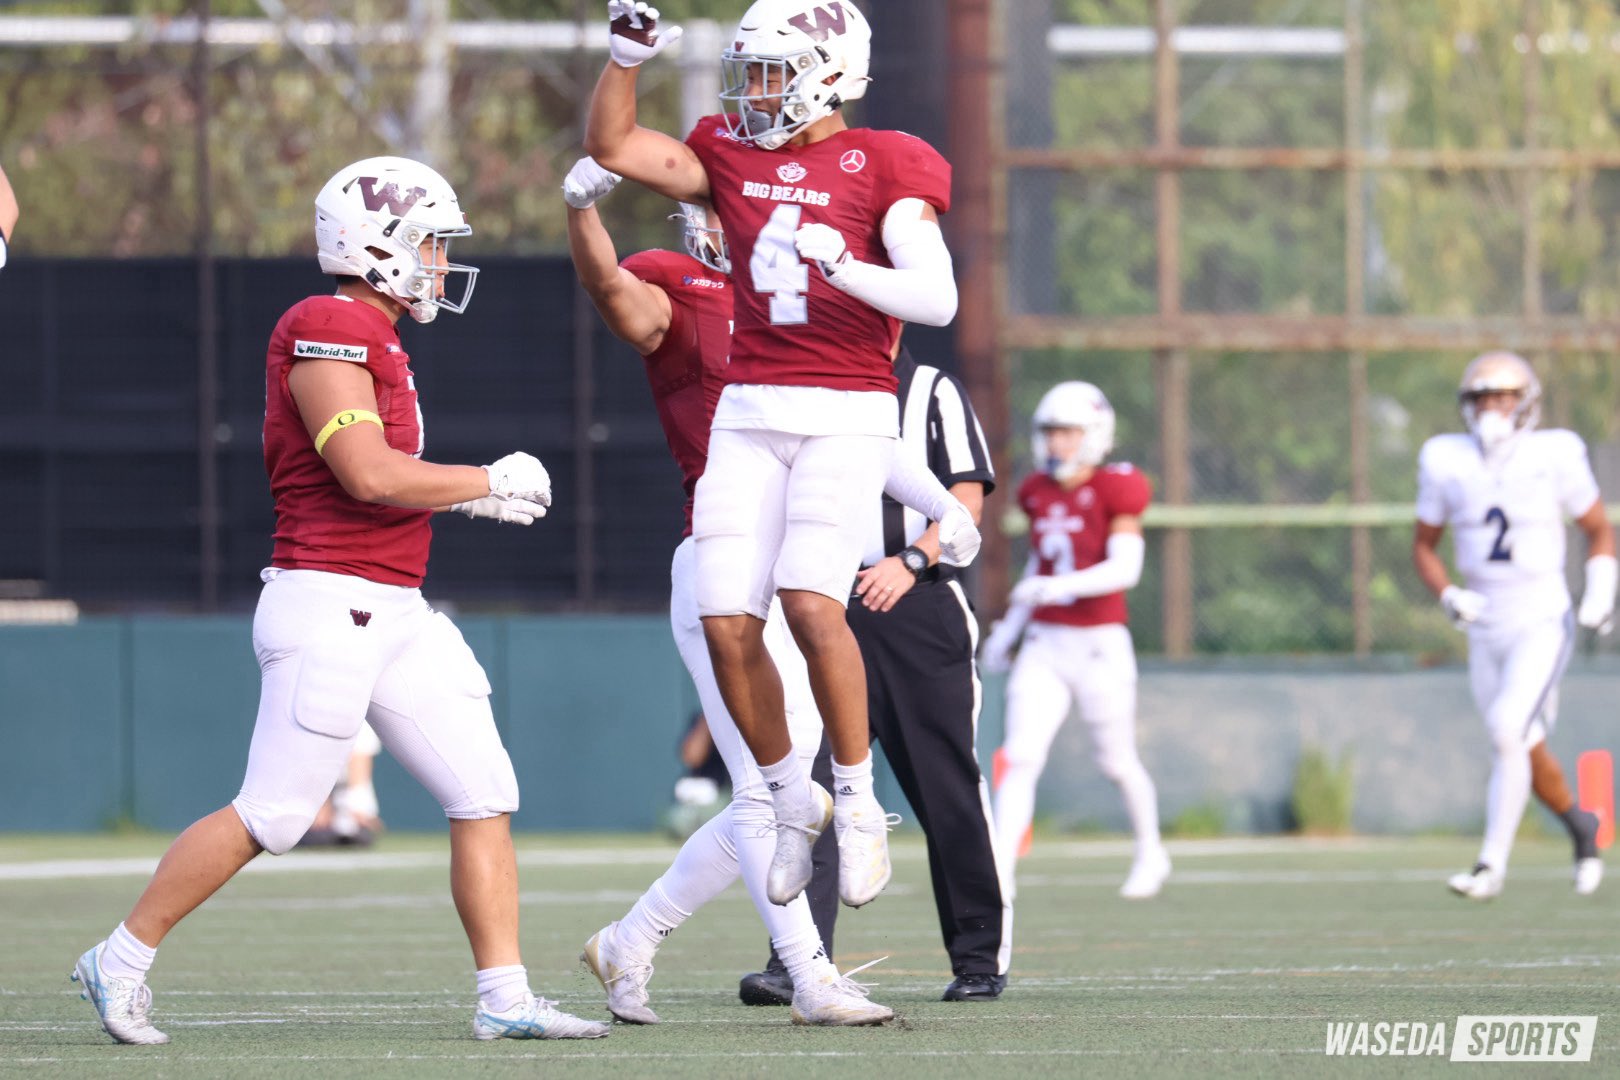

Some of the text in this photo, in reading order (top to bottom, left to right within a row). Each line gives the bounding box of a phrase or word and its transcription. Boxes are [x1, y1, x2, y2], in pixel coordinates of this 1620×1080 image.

[787, 1, 847, 43] W
[357, 176, 427, 218] W
[742, 181, 831, 207] BIG BEARS
[750, 203, 809, 326] 4
[305, 345, 364, 359] Hibrid-Turf
[1484, 506, 1513, 561] 2
[349, 608, 372, 627] W
